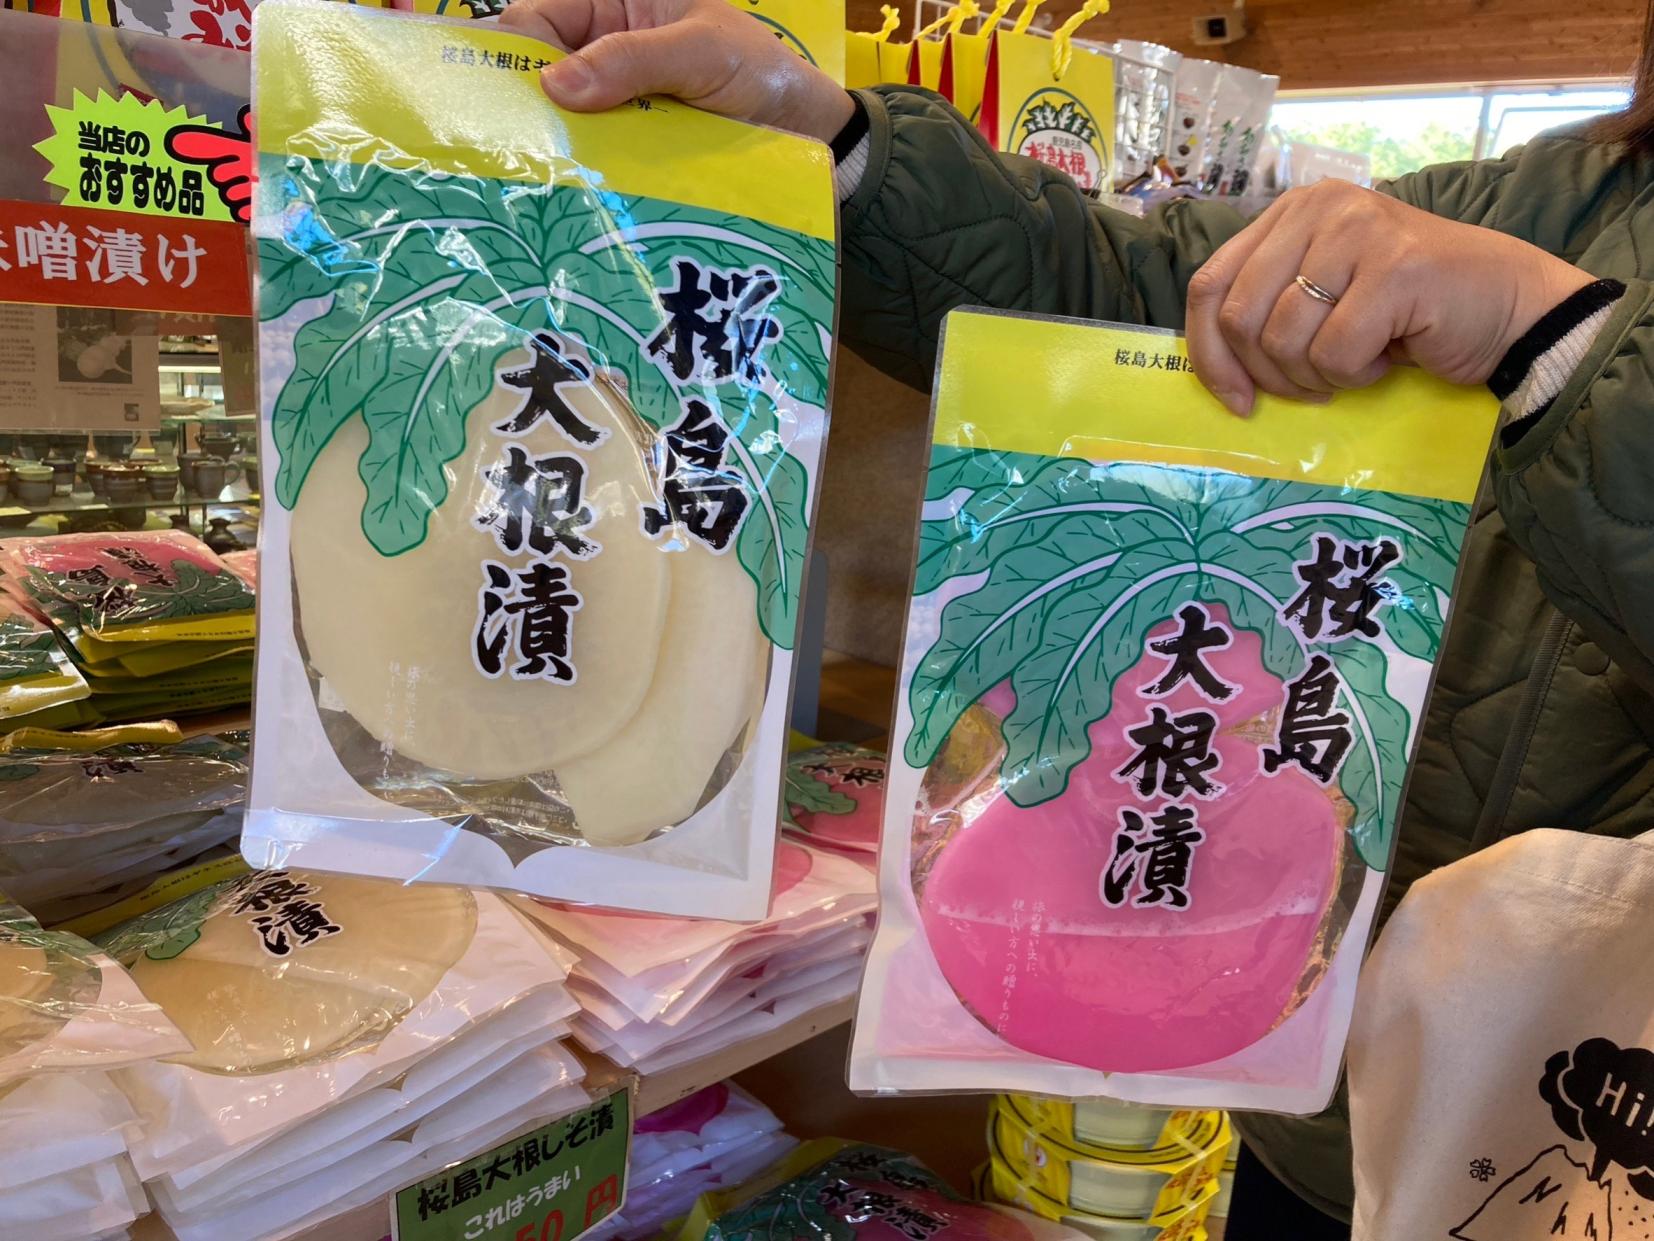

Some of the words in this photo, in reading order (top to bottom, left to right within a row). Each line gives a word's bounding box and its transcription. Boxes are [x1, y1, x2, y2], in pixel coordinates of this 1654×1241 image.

[78, 121, 150, 157] 当店の
[80, 152, 205, 216] おすすめ品
[645, 259, 781, 550] 桜島
[475, 332, 603, 682] 大根漬
[1262, 536, 1400, 783] 桜島
[1103, 604, 1239, 908] 大根漬
[417, 1103, 614, 1221] 桜島大根しそ漬
[464, 1165, 581, 1240] これはうまい
[584, 1173, 619, 1231] 円
